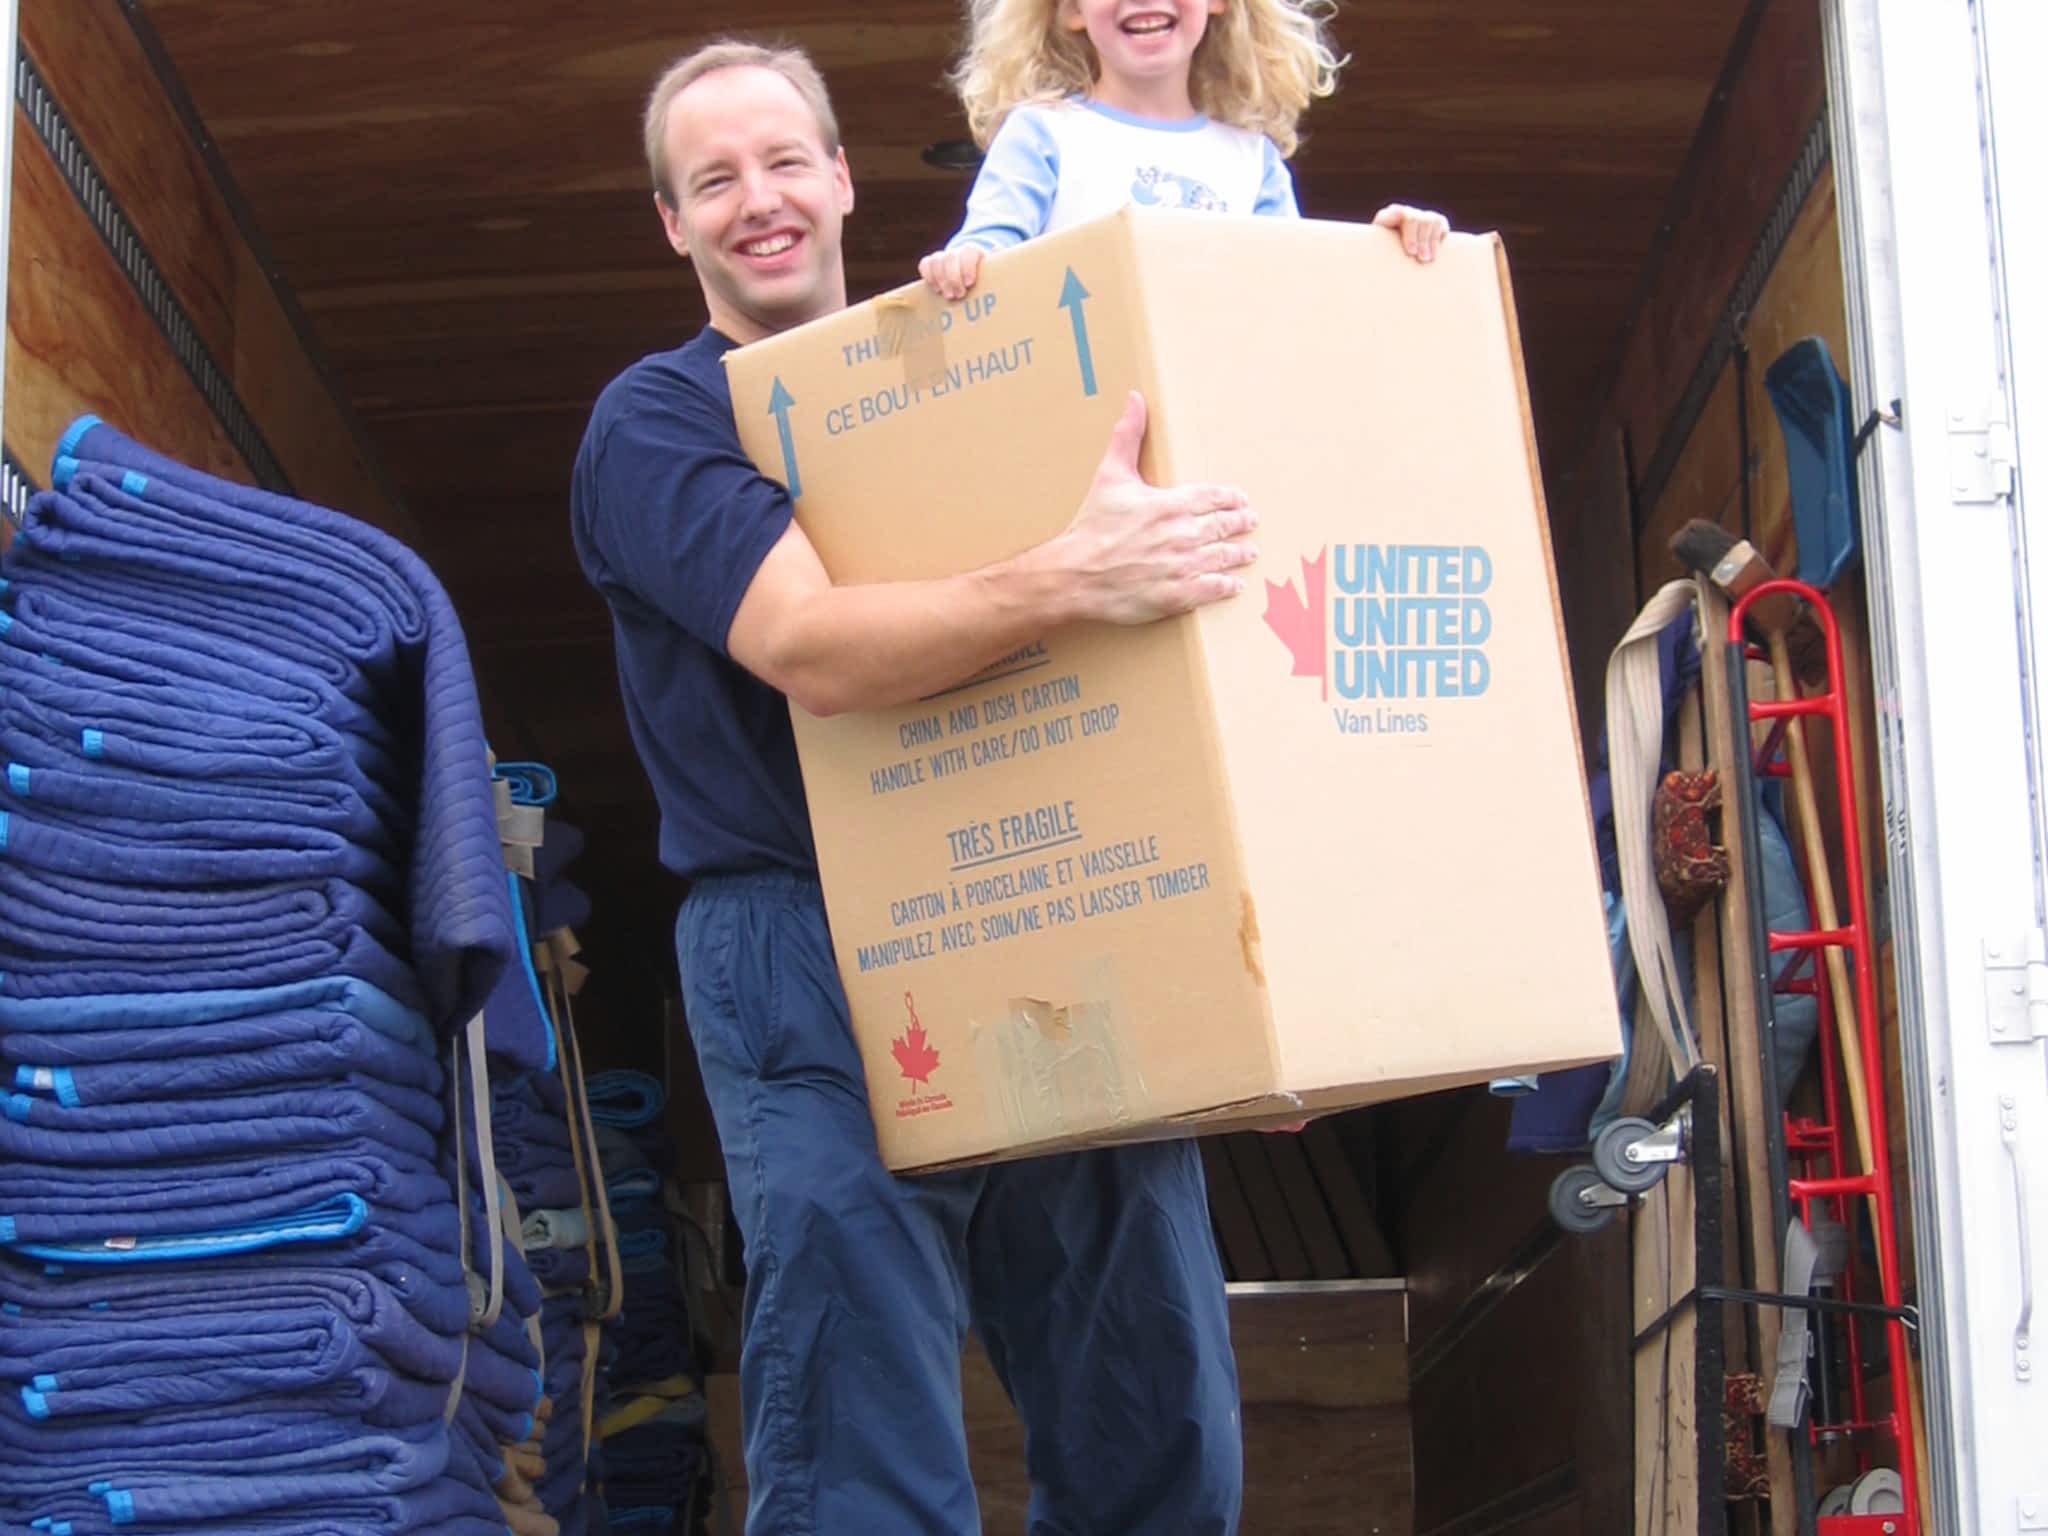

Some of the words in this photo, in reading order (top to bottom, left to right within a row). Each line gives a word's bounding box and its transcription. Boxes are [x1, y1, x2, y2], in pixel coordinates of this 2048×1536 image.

[842, 334, 884, 367] THI
[964, 293, 997, 322] UP
[826, 404, 857, 435] CE
[966, 338, 1034, 384] HAUT
[1334, 543, 1494, 595] UNITED
[1334, 597, 1493, 647] UNITED
[899, 715, 944, 749] CHINA
[949, 704, 979, 735] AND
[983, 692, 1017, 725] DISH
[1022, 673, 1080, 714] CARTON
[1334, 649, 1491, 700] UNITED
[870, 758, 925, 794] HANDLE
[929, 746, 968, 778] WITH
[1044, 715, 1074, 746] NOT
[1080, 703, 1120, 737] DROP
[1333, 706, 1373, 734] Van
[1376, 706, 1429, 734] Lines
[946, 820, 995, 863] TRÈS
[999, 800, 1079, 851] FRAGILE
[857, 931, 936, 972] MANIPULEZ
[940, 921, 976, 952] AVEC
[1046, 896, 1076, 926] PAS
[1080, 880, 1142, 917] LAISSER
[1146, 863, 1210, 901] TOMBER
[891, 890, 946, 926] CARTON
[965, 864, 1052, 908] PORCELAINE
[1055, 857, 1074, 885] ET
[1080, 835, 1159, 878] VAISSELLE
